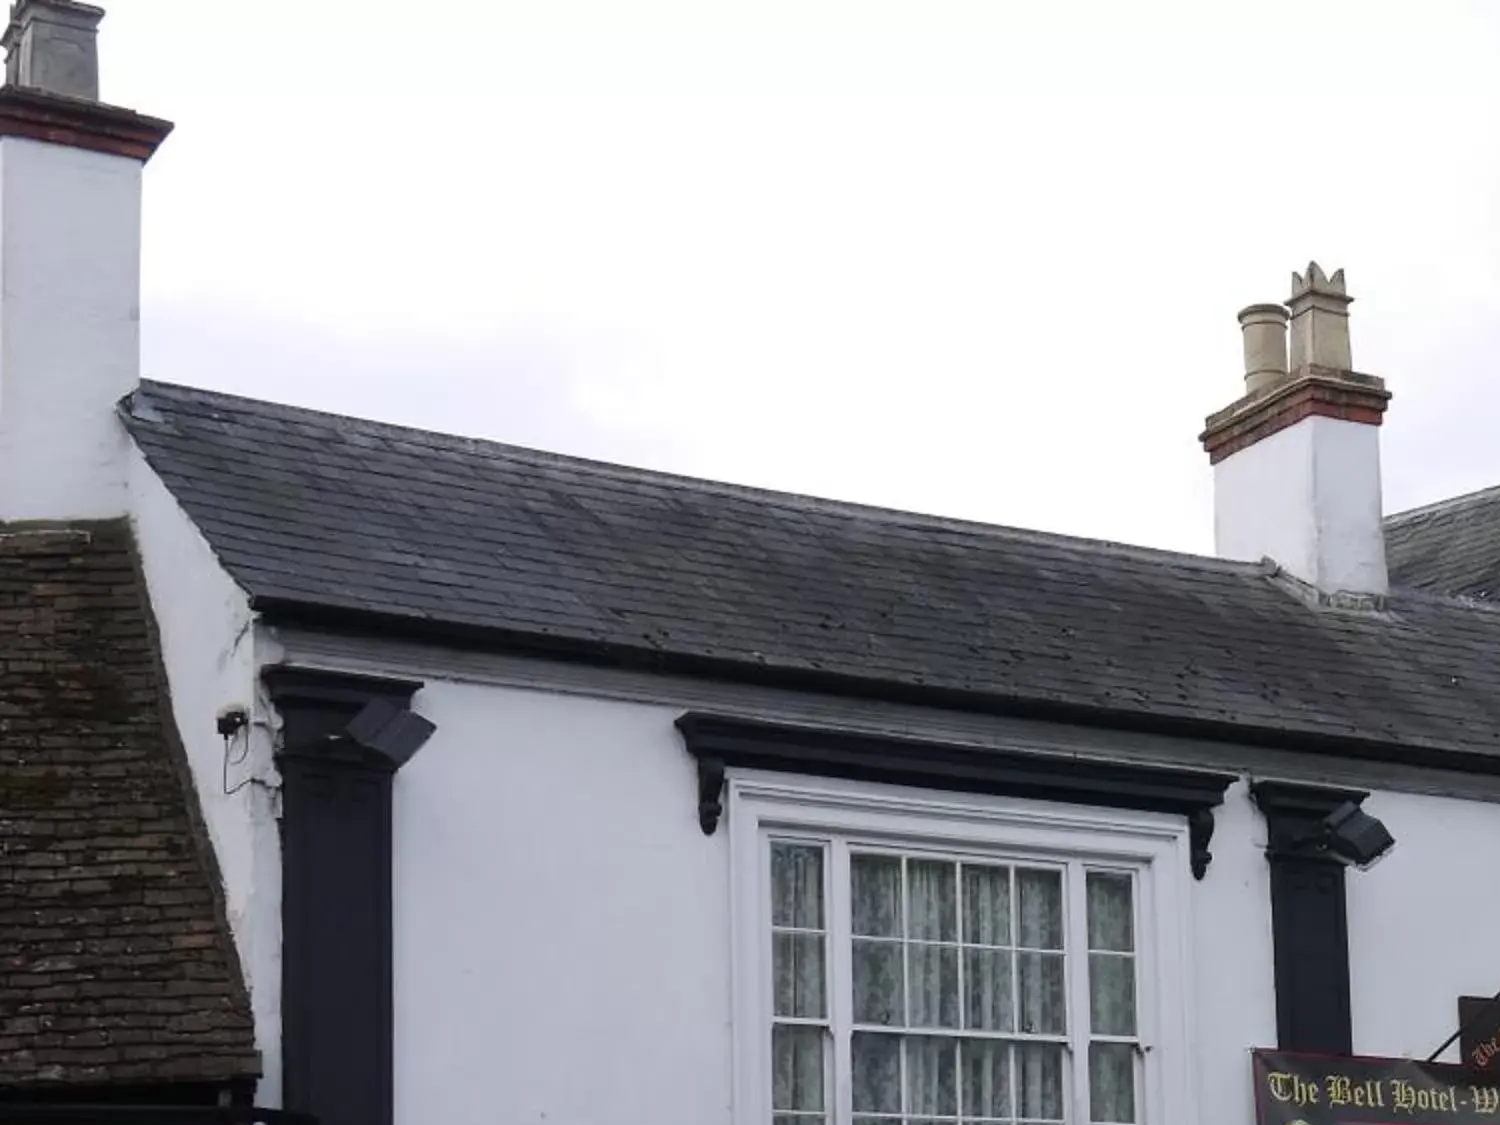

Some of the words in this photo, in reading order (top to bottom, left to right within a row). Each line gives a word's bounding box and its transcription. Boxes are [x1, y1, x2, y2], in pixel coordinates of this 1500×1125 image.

[1472, 1037, 1500, 1067] The
[1268, 1071, 1319, 1106] The
[1326, 1074, 1385, 1108] Bell
